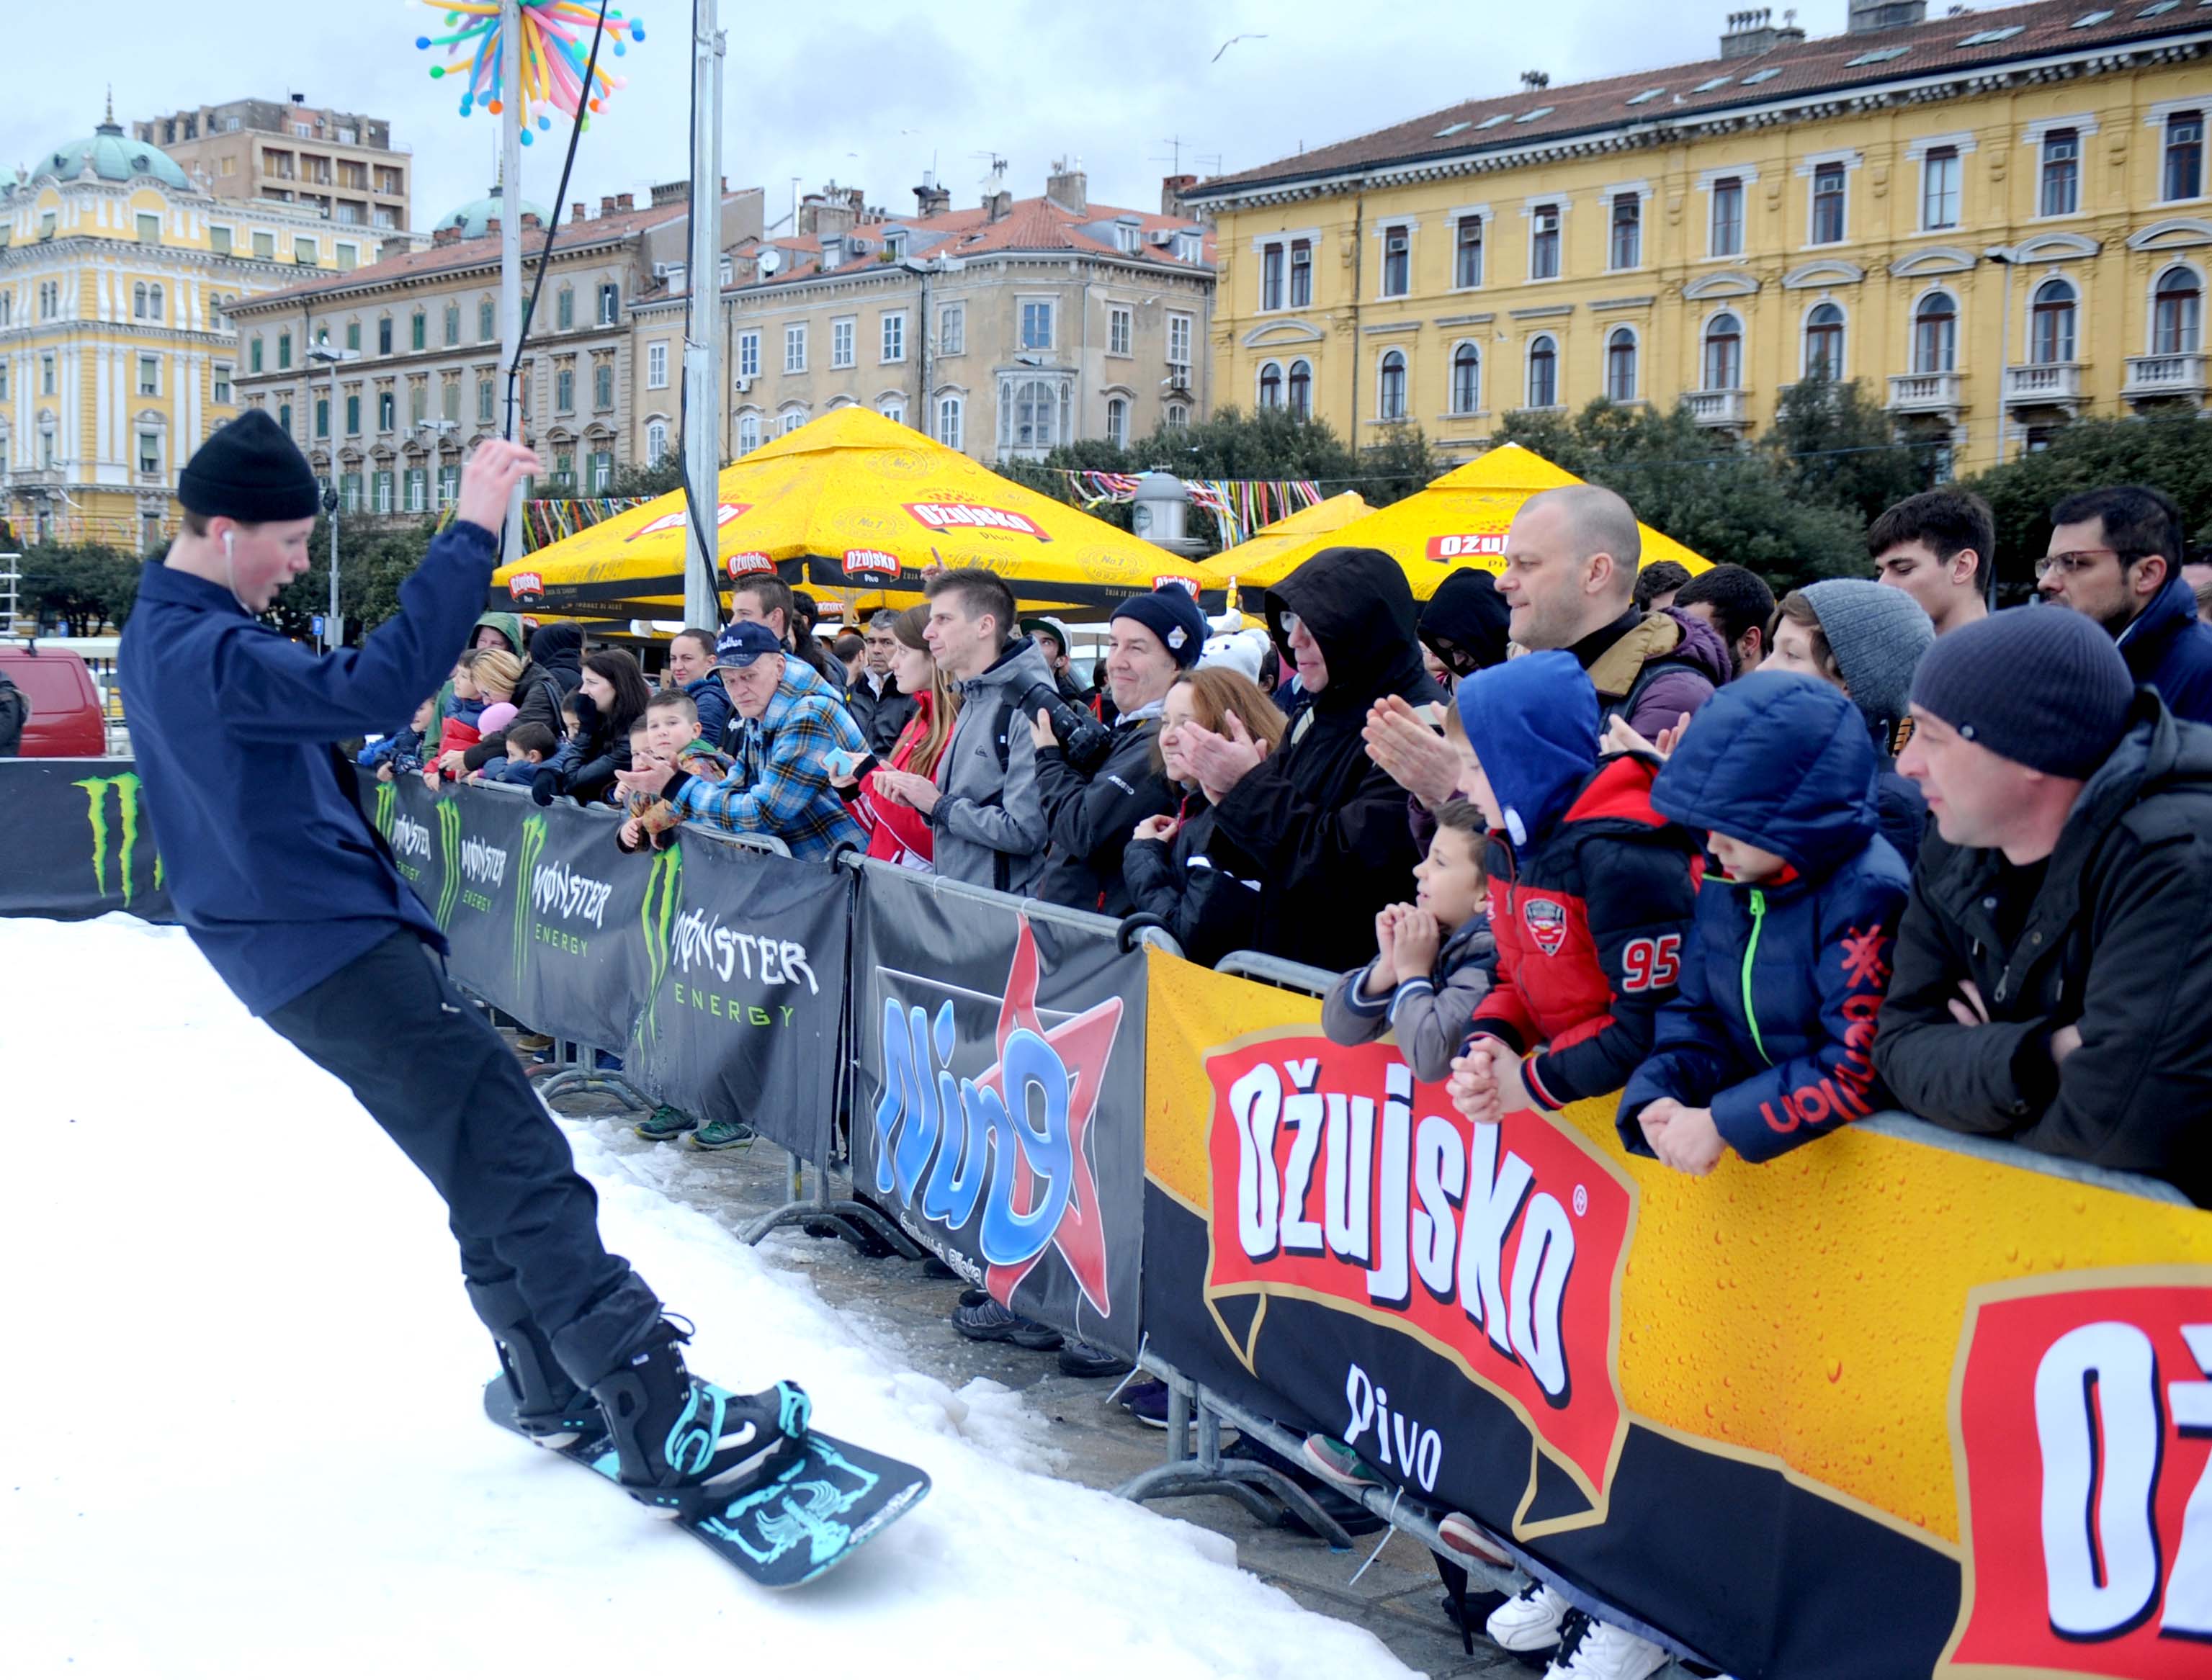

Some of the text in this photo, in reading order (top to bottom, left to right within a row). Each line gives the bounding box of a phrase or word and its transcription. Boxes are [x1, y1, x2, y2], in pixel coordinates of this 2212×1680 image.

[846, 549, 897, 572] Ožujsko
[1441, 534, 1510, 556] Ožuj
[729, 552, 773, 575] Ožujsko
[462, 889, 493, 915] ENERGY
[535, 922, 589, 958] ENERGY
[1622, 933, 1681, 993] 95
[674, 982, 794, 1028] ENERGY
[1228, 1057, 1577, 1401] Ožujsko
[1343, 1363, 1443, 1493] Pivo
